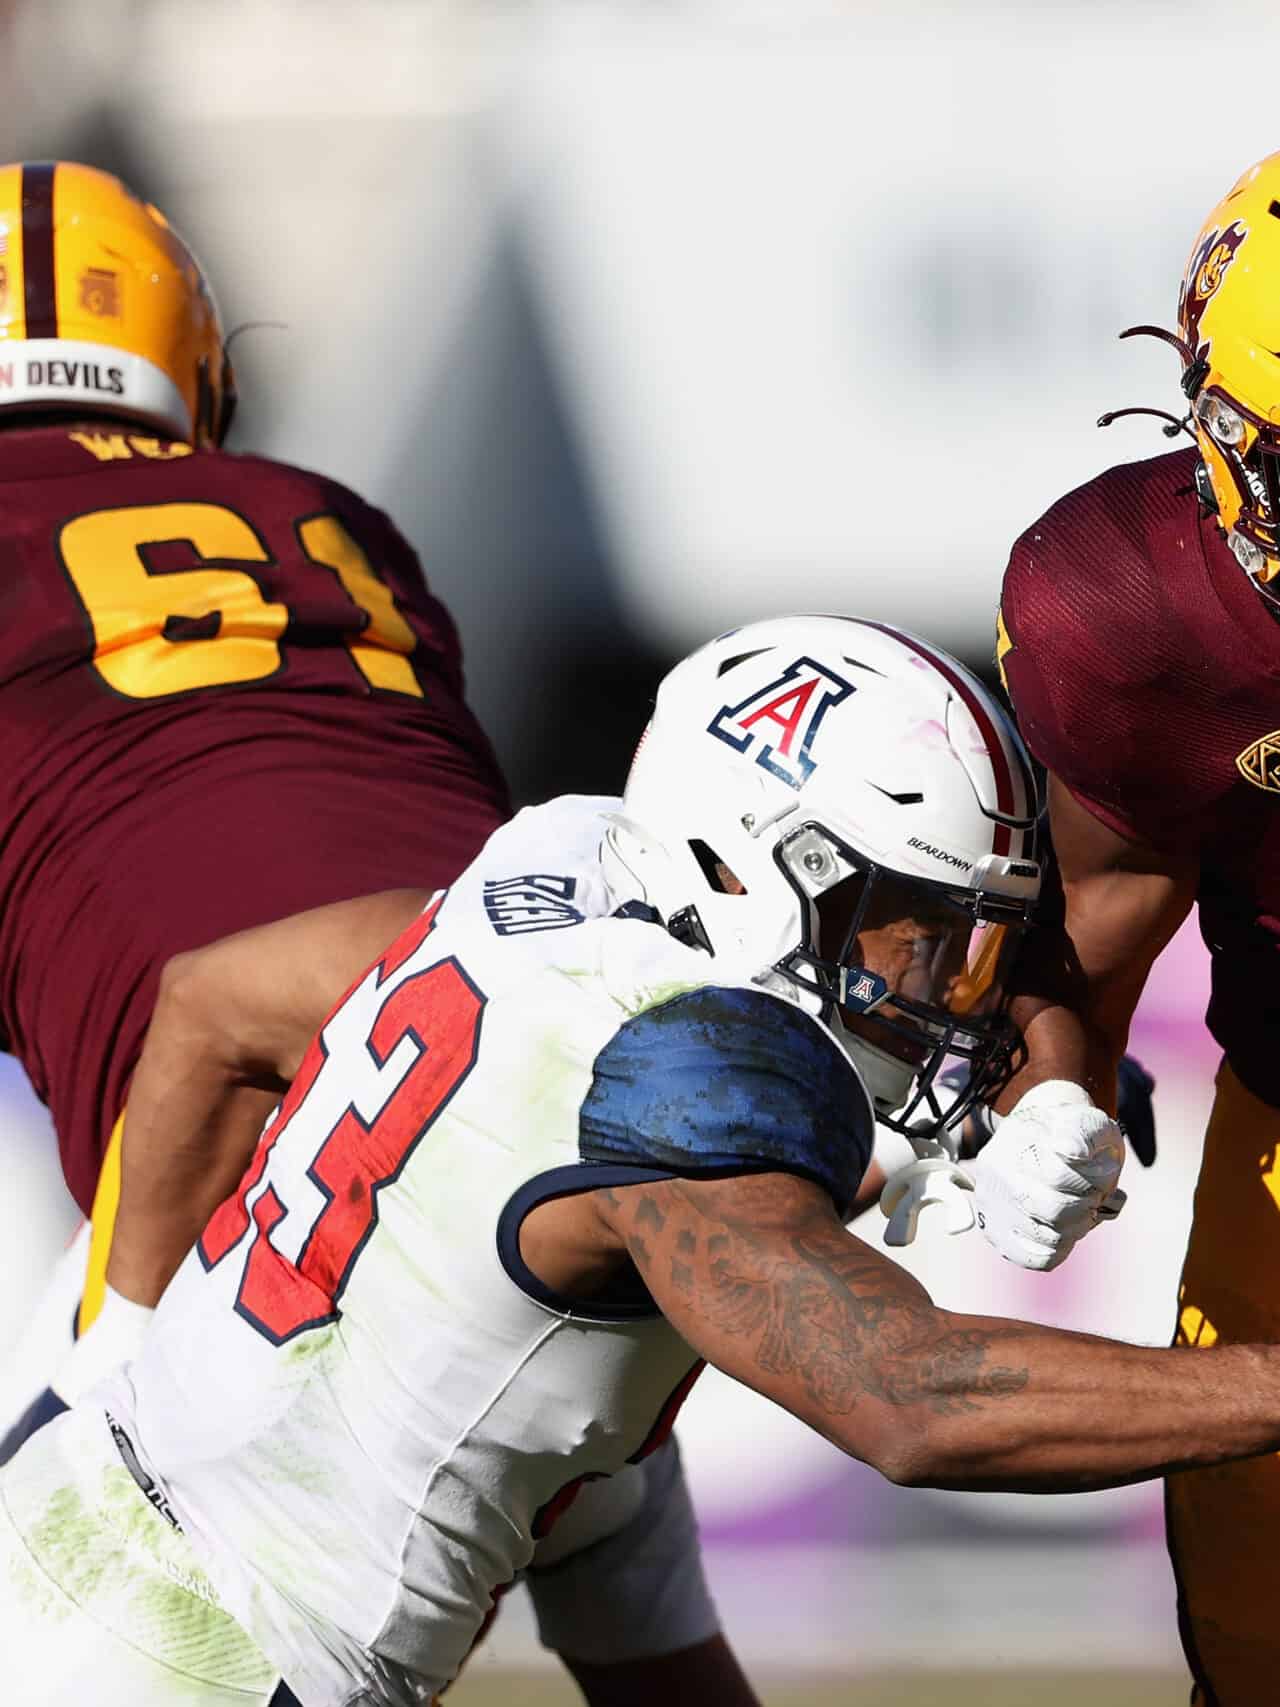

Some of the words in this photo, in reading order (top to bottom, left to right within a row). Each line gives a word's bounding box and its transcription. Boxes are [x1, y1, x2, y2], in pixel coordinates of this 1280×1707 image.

[27, 361, 125, 394] DEVILS
[56, 501, 425, 701] 61
[706, 655, 857, 791] A
[906, 836, 974, 872] BEARDOWN
[483, 874, 587, 936] REED
